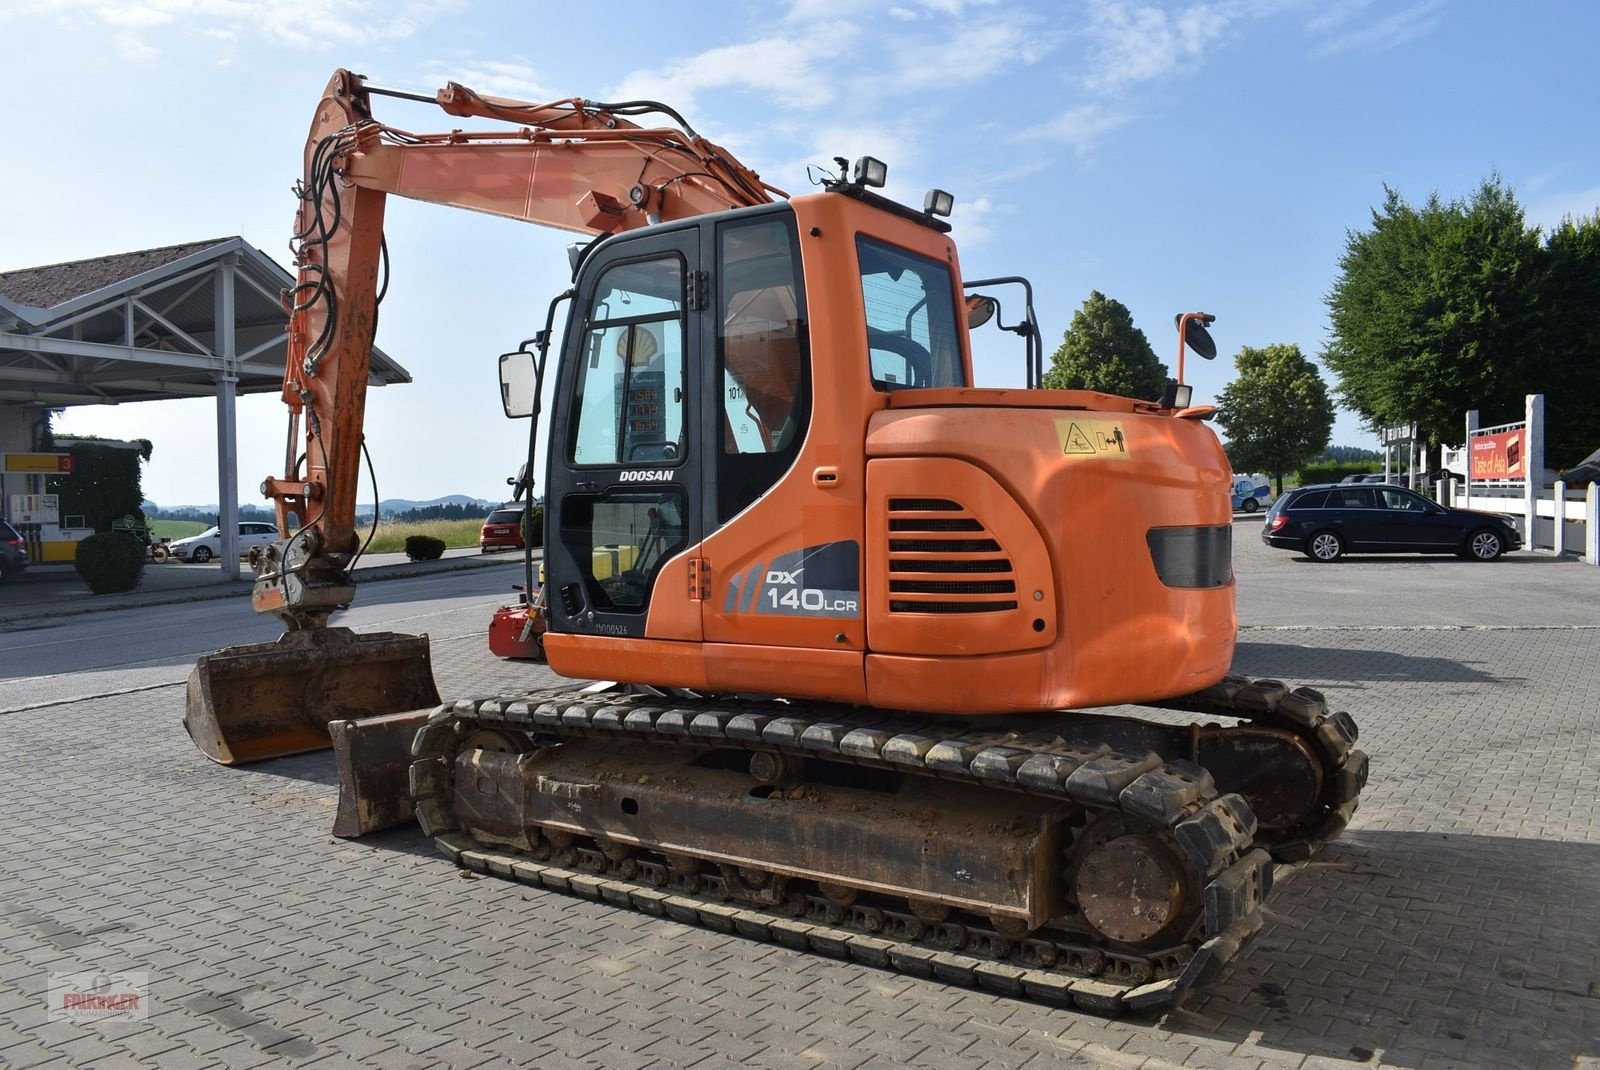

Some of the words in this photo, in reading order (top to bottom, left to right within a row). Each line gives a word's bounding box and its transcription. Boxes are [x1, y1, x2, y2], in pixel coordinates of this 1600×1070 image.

[62, 458, 72, 470] 3
[619, 470, 674, 482] DOOSAN
[765, 568, 805, 585] DX
